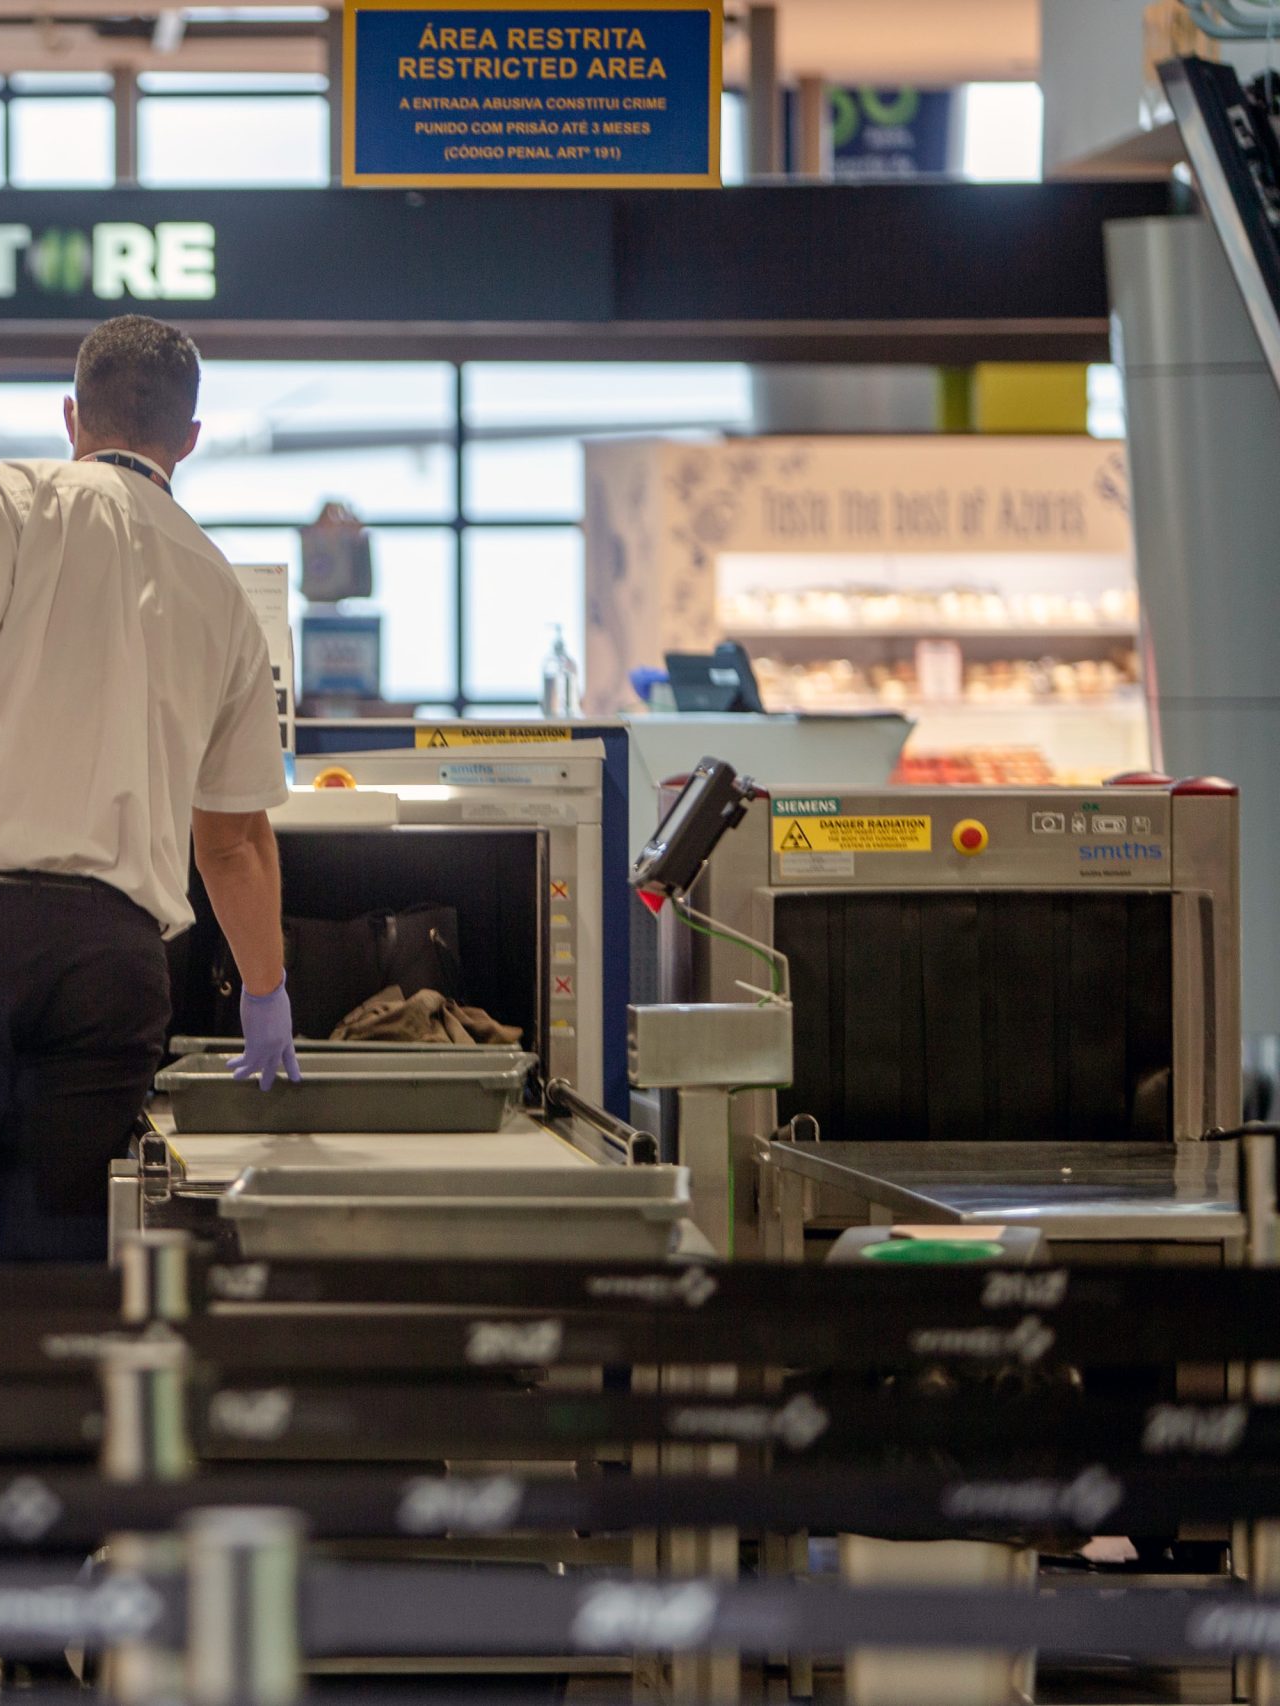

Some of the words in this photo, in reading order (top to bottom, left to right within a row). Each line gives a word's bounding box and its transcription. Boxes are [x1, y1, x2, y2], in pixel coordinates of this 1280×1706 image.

[418, 22, 498, 50] ÁREA
[507, 28, 647, 50] RESTRITA
[398, 57, 578, 79] RESTRICTED
[586, 57, 668, 79] AREA
[399, 97, 410, 110] A
[412, 97, 480, 110] ENTRADA
[482, 97, 543, 110] ABUSIVA
[545, 97, 620, 110] CONSTITUI
[622, 97, 668, 110] CRIME
[414, 121, 469, 134] PUNIDO
[470, 121, 504, 134] COM
[505, 118, 559, 134] PRISÃO
[561, 118, 589, 134] ATÉ
[591, 121, 600, 134] 3
[602, 121, 652, 135] MESES
[444, 144, 505, 161] (CÓDIGO
[507, 146, 554, 159] PENAL
[593, 146, 622, 161] 191)
[461, 727, 506, 738] DANGER
[508, 727, 567, 738] RADIATION
[775, 800, 838, 813] SIEMENS
[819, 819, 864, 829] DANGER
[867, 819, 926, 829] RADIATION
[1078, 841, 1163, 860] smiths
